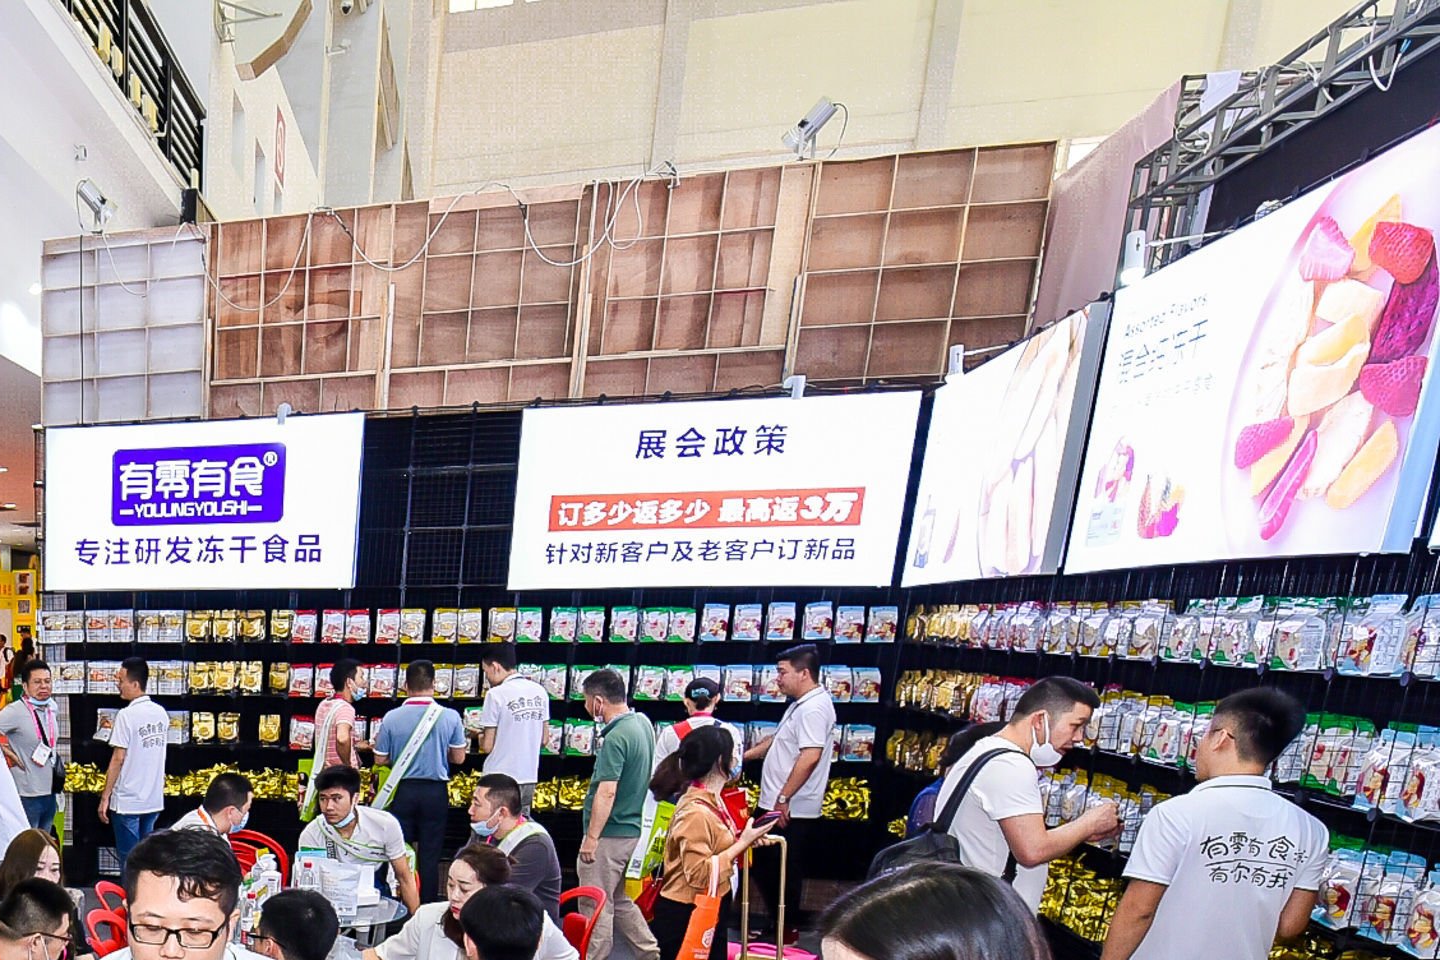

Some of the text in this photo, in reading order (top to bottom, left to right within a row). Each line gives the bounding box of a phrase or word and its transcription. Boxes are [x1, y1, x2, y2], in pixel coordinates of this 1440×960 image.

[636, 425, 788, 459] 展会政策
[119, 456, 265, 501] 有零有食
[558, 492, 859, 527] 订多少返多少 最高返3万
[75, 534, 323, 565] 专注研发冻干食品
[545, 538, 857, 565] 针对新客户及老客户订新品
[1199, 831, 1296, 861] 有零有食
